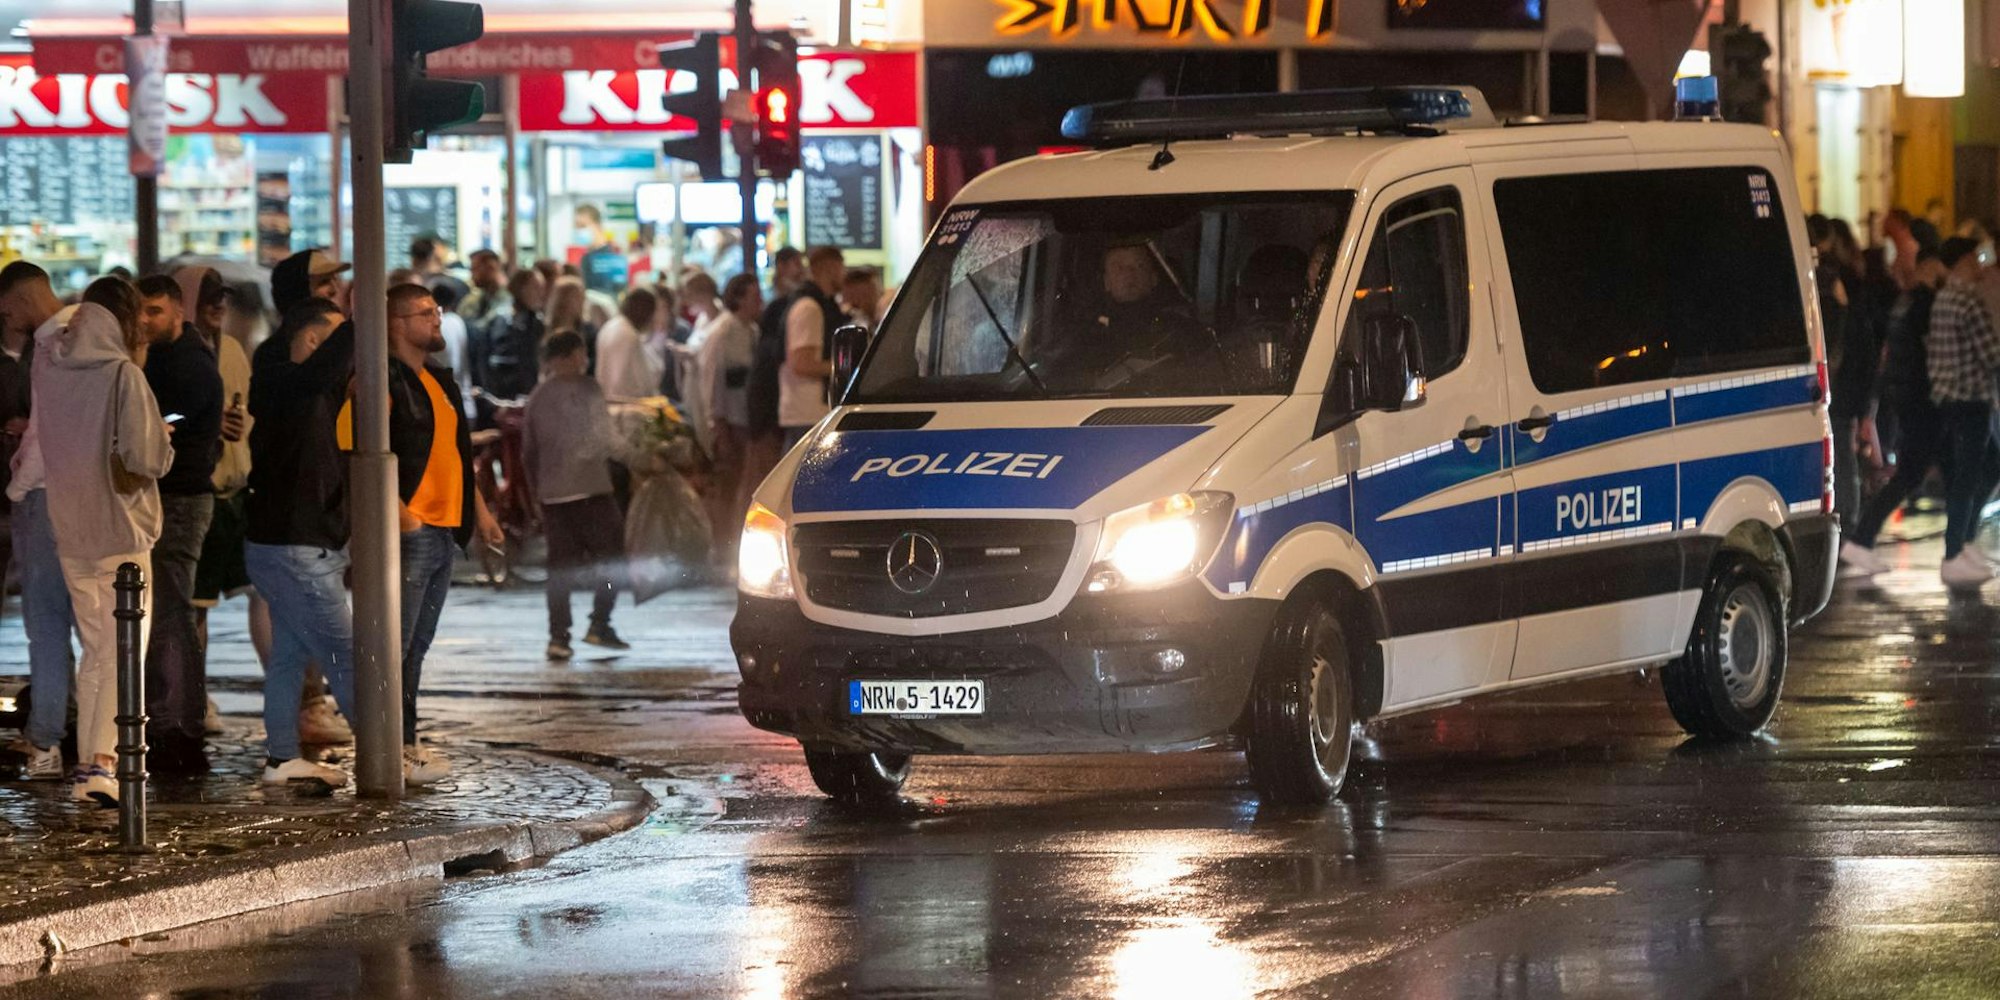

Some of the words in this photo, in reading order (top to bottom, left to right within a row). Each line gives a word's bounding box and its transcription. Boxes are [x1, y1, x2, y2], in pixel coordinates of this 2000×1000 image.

[425, 41, 574, 70] andwiches
[558, 59, 875, 124] KIK
[947, 208, 980, 223] NRW
[850, 451, 1063, 482] POLIZEI
[1556, 484, 1642, 532] POLIZEI
[861, 686, 896, 710] NRW
[907, 686, 980, 710] 5-1429
